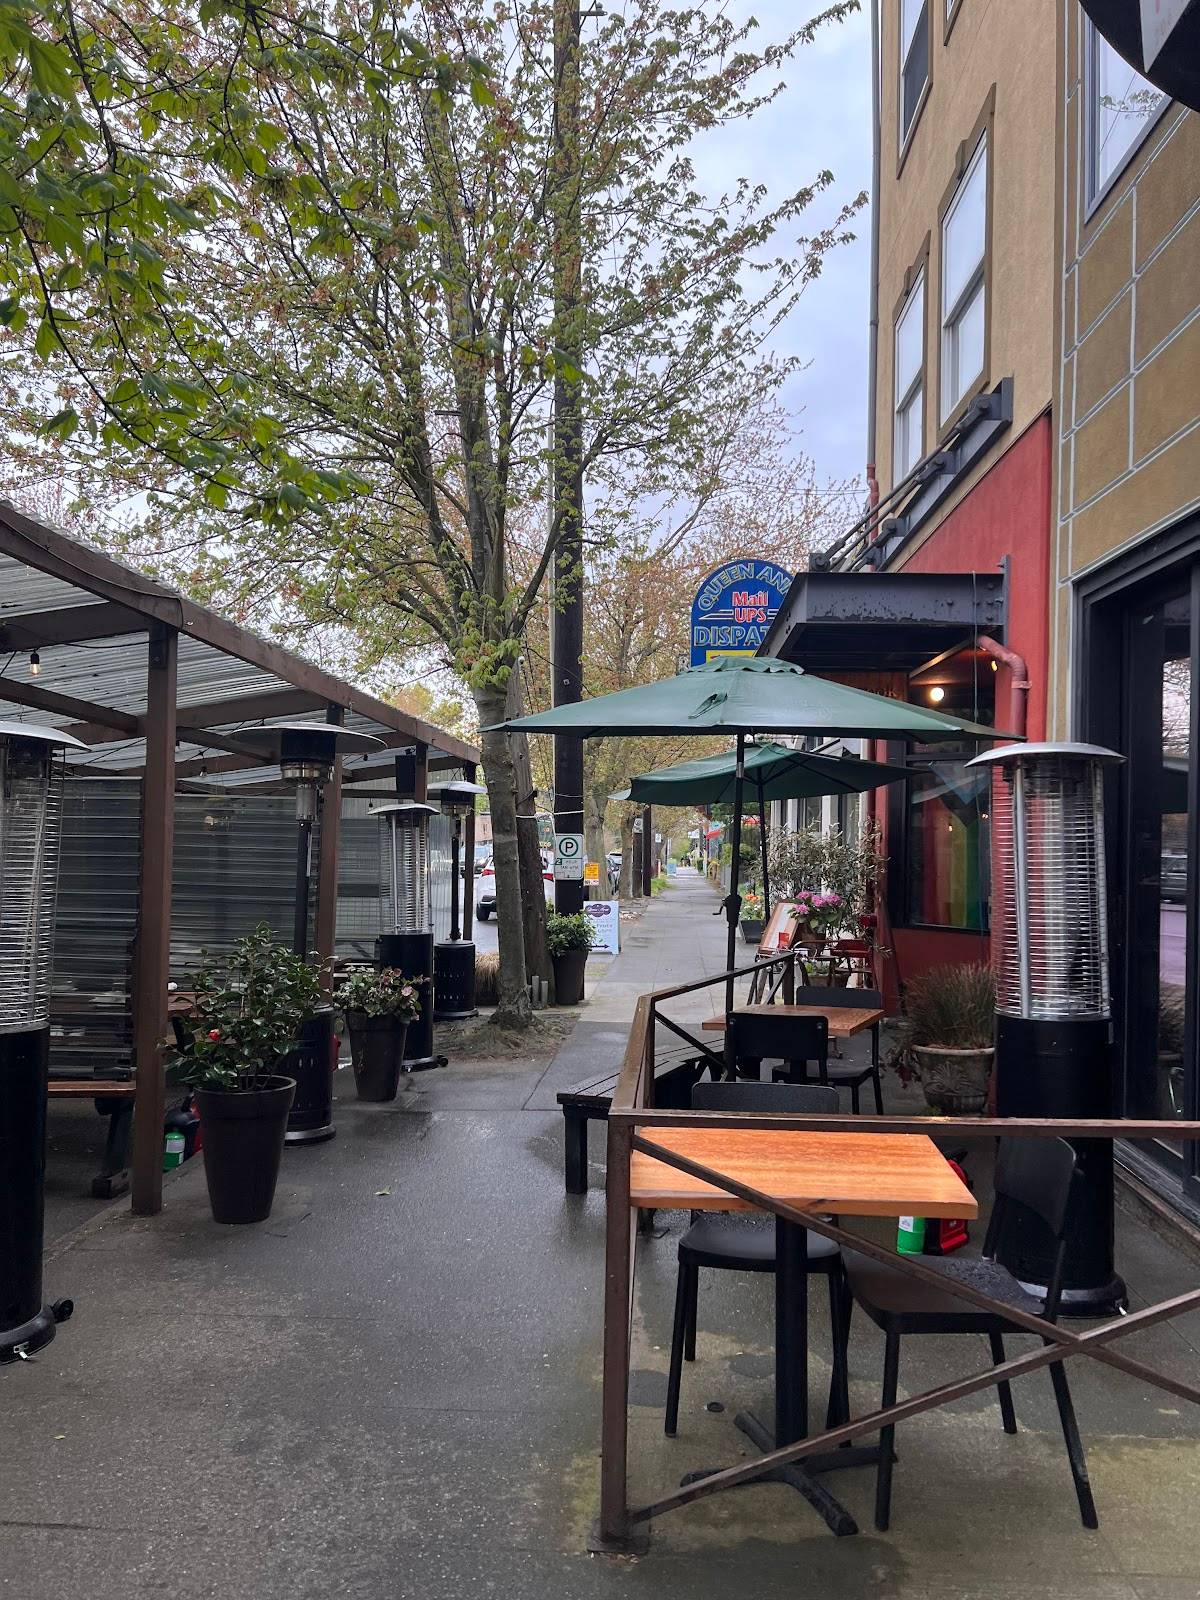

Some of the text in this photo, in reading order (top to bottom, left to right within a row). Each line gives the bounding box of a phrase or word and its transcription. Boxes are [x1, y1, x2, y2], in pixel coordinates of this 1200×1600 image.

[698, 563, 754, 610] QUEEN
[732, 591, 768, 606] Mail
[735, 608, 767, 623] UPS
[565, 841, 574, 853] P
